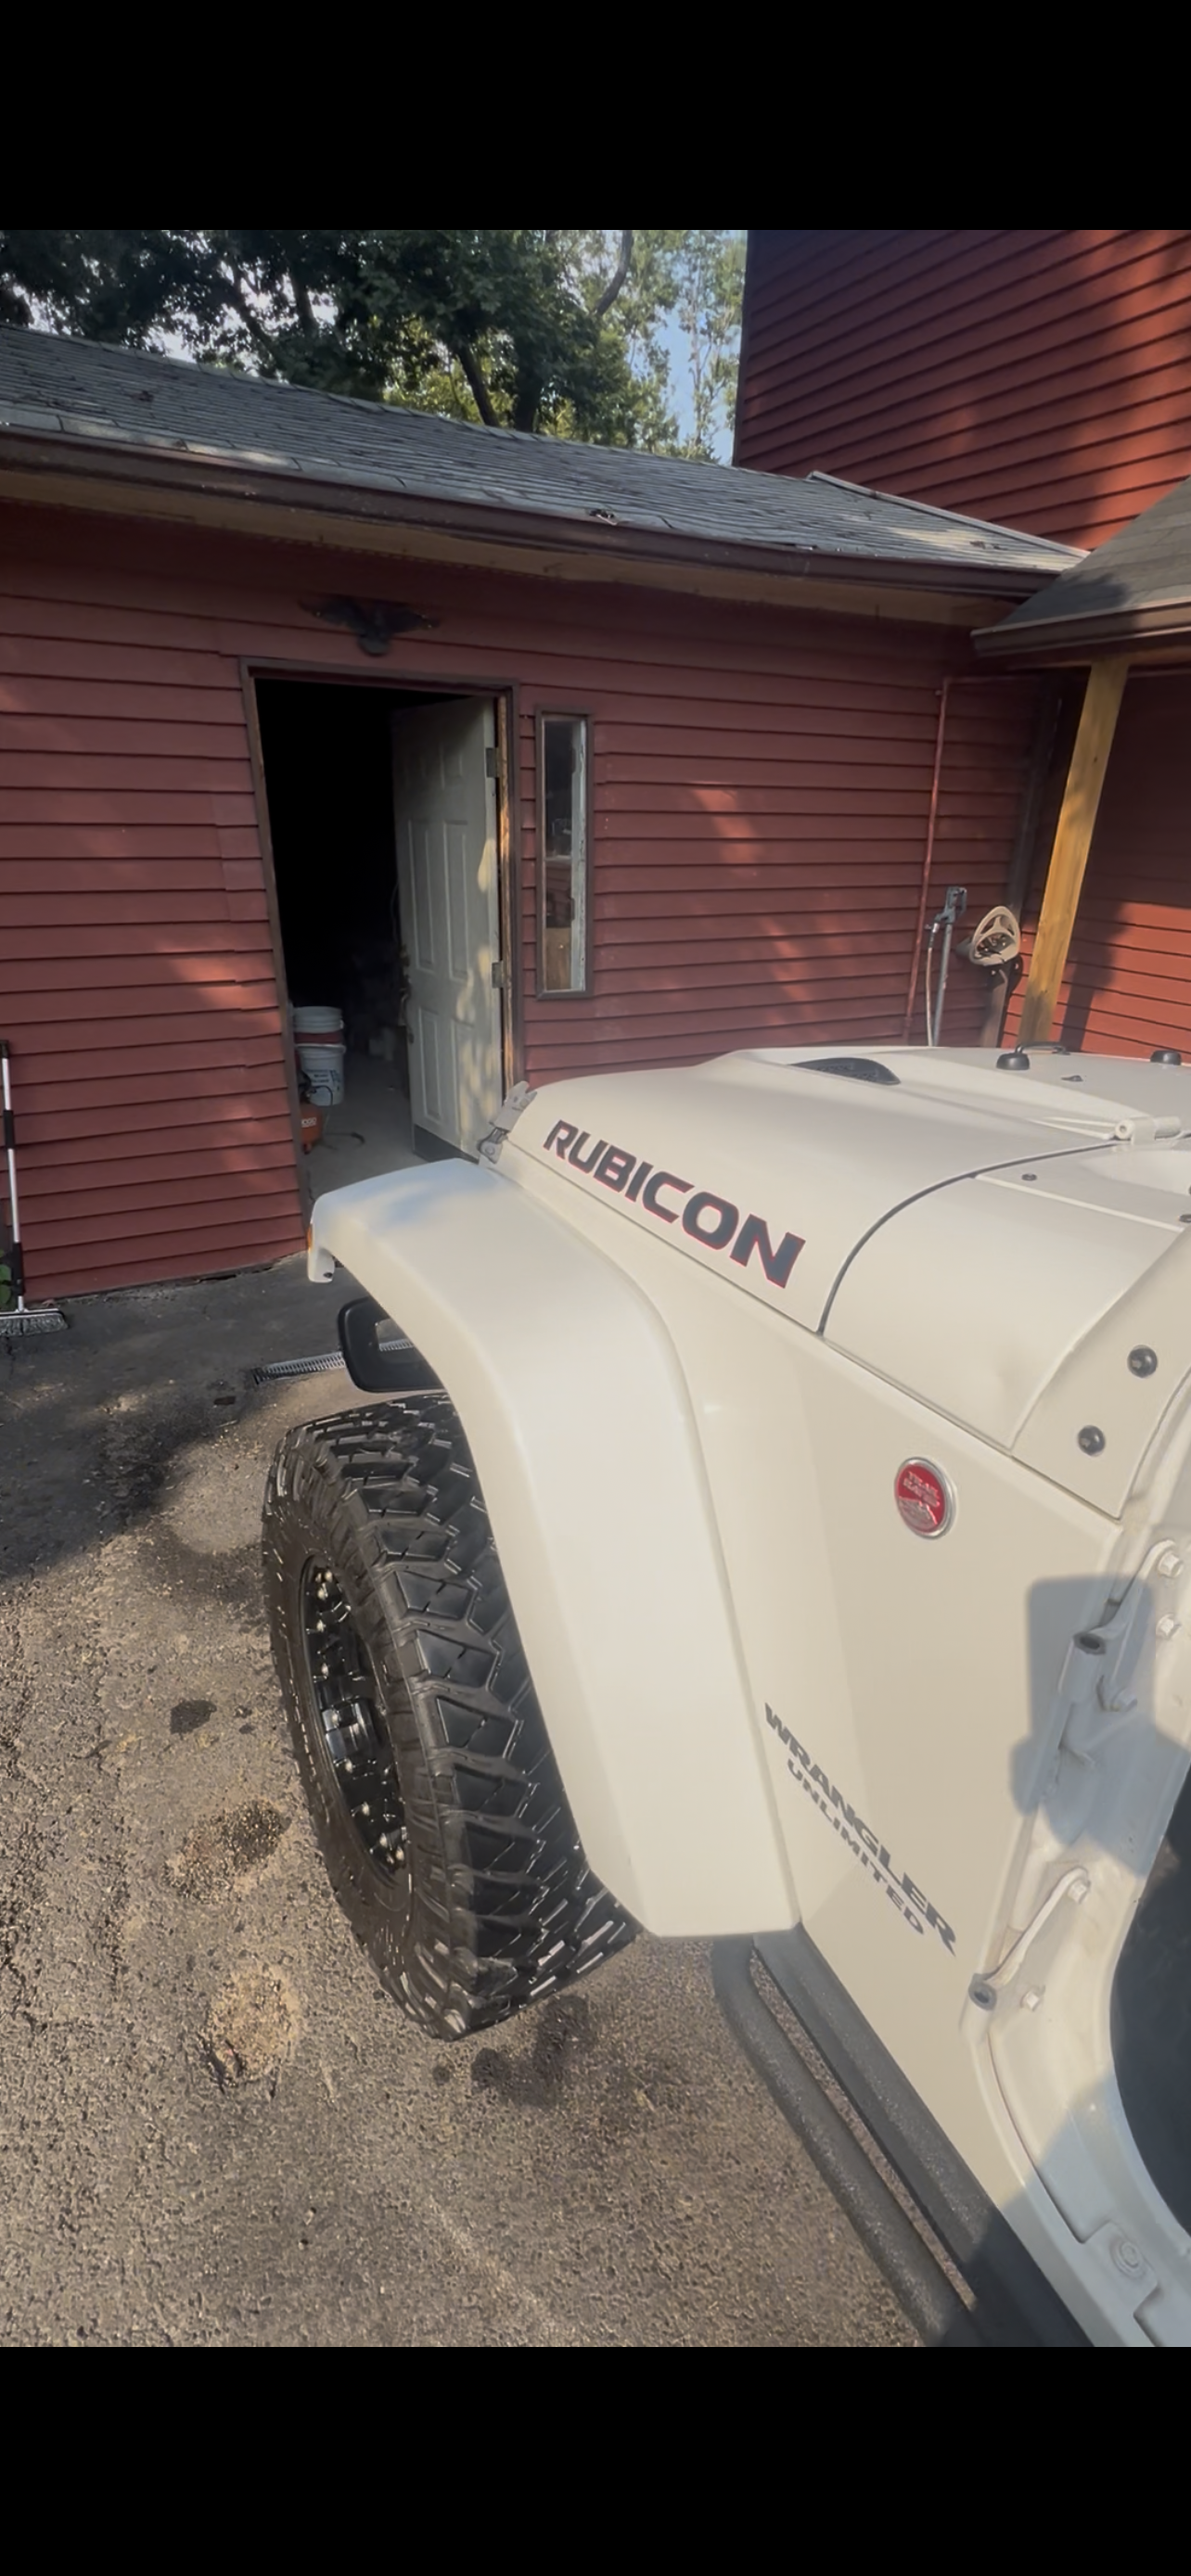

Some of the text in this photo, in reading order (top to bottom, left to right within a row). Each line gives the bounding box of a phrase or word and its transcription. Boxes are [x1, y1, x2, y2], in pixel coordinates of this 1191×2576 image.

[543, 1118, 806, 1289] RUBICON
[764, 1702, 956, 1957] WRANGLER
[788, 1758, 924, 1935] UNLIMITED
